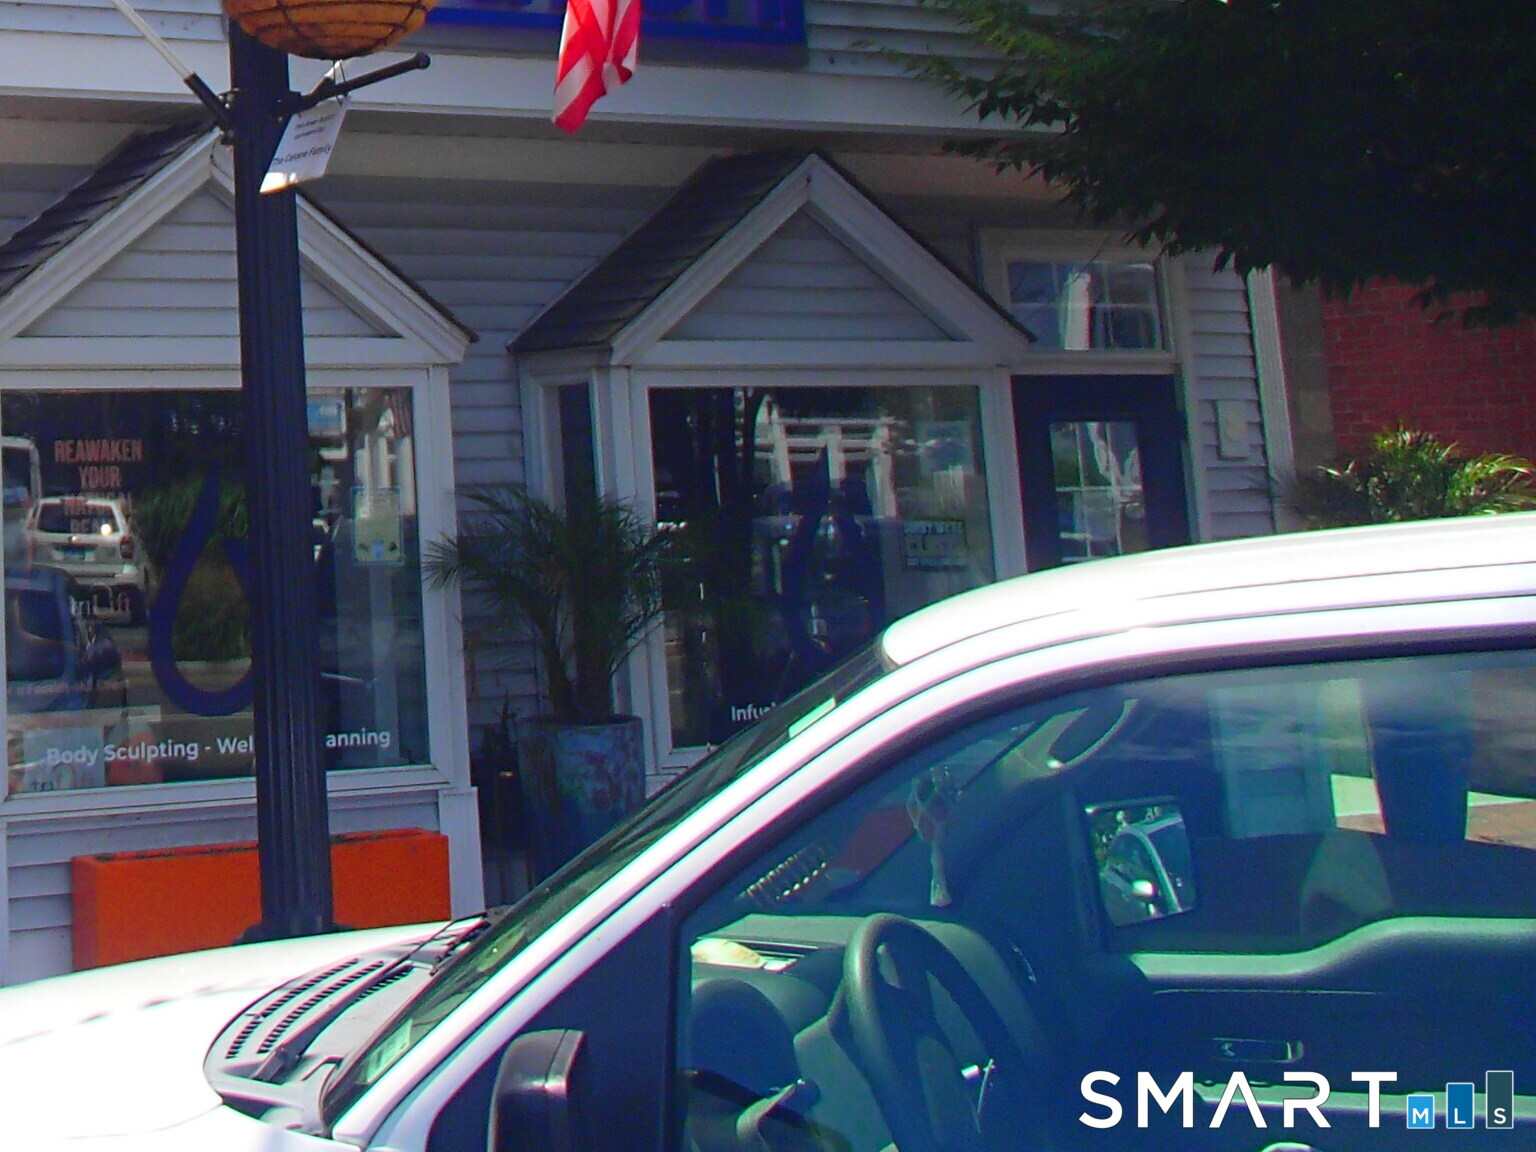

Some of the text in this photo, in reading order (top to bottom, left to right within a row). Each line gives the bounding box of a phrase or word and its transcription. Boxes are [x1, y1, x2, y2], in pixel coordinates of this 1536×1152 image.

[55, 439, 144, 463] REAWAKEN
[78, 466, 121, 489] YOUR
[731, 701, 776, 721] Infu
[46, 745, 99, 766] Body
[103, 739, 199, 763] Sculpting
[216, 735, 254, 754] Wel
[325, 727, 391, 748] anning
